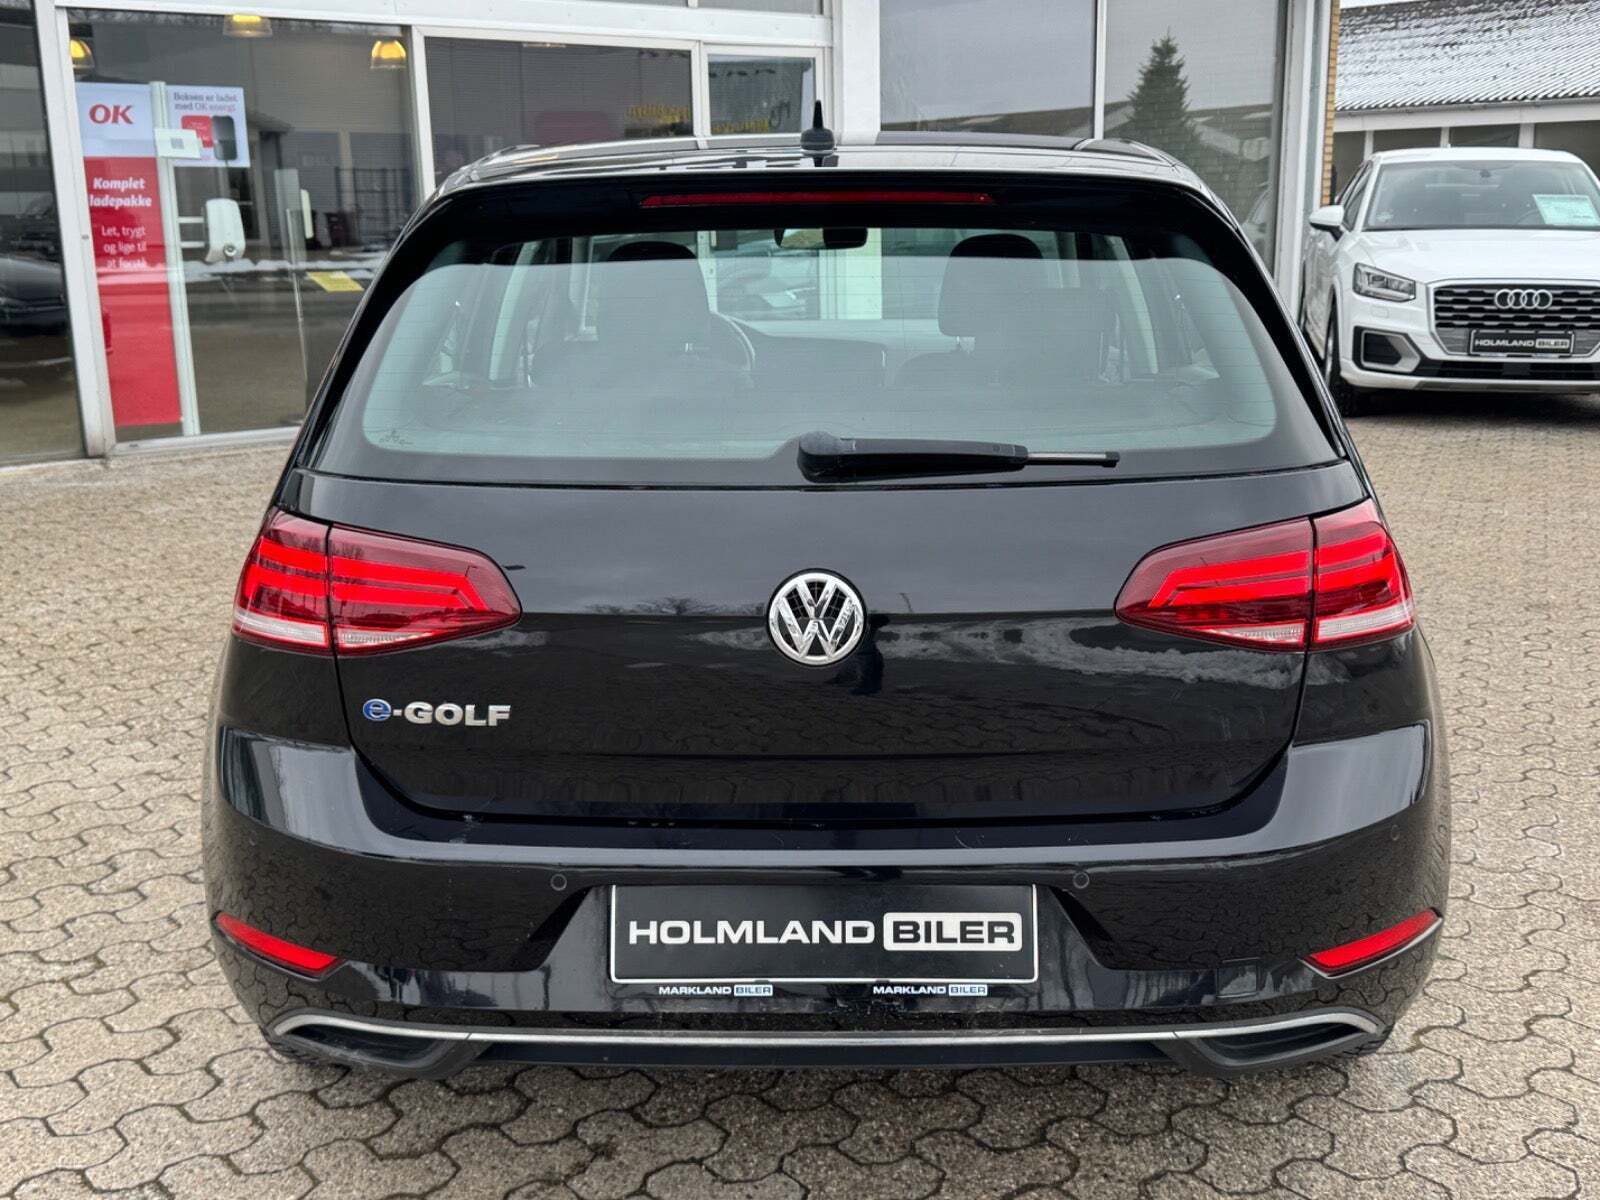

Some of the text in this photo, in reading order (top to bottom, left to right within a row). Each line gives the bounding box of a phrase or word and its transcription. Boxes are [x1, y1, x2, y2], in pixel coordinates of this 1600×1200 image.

[89, 104, 134, 124] OK
[93, 177, 145, 192] Komplet
[90, 194, 152, 210] ladepakke
[101, 226, 146, 239] Let, trygt
[103, 243, 117, 255] og
[118, 241, 136, 255] lige
[1475, 339, 1569, 348] HOLMLAND BILER
[362, 698, 511, 727] e-GOLF
[629, 920, 1015, 944] HOLMLAND BILER
[658, 985, 772, 996] MARKLAND BILER
[873, 985, 987, 996] MARKLAND BILER
